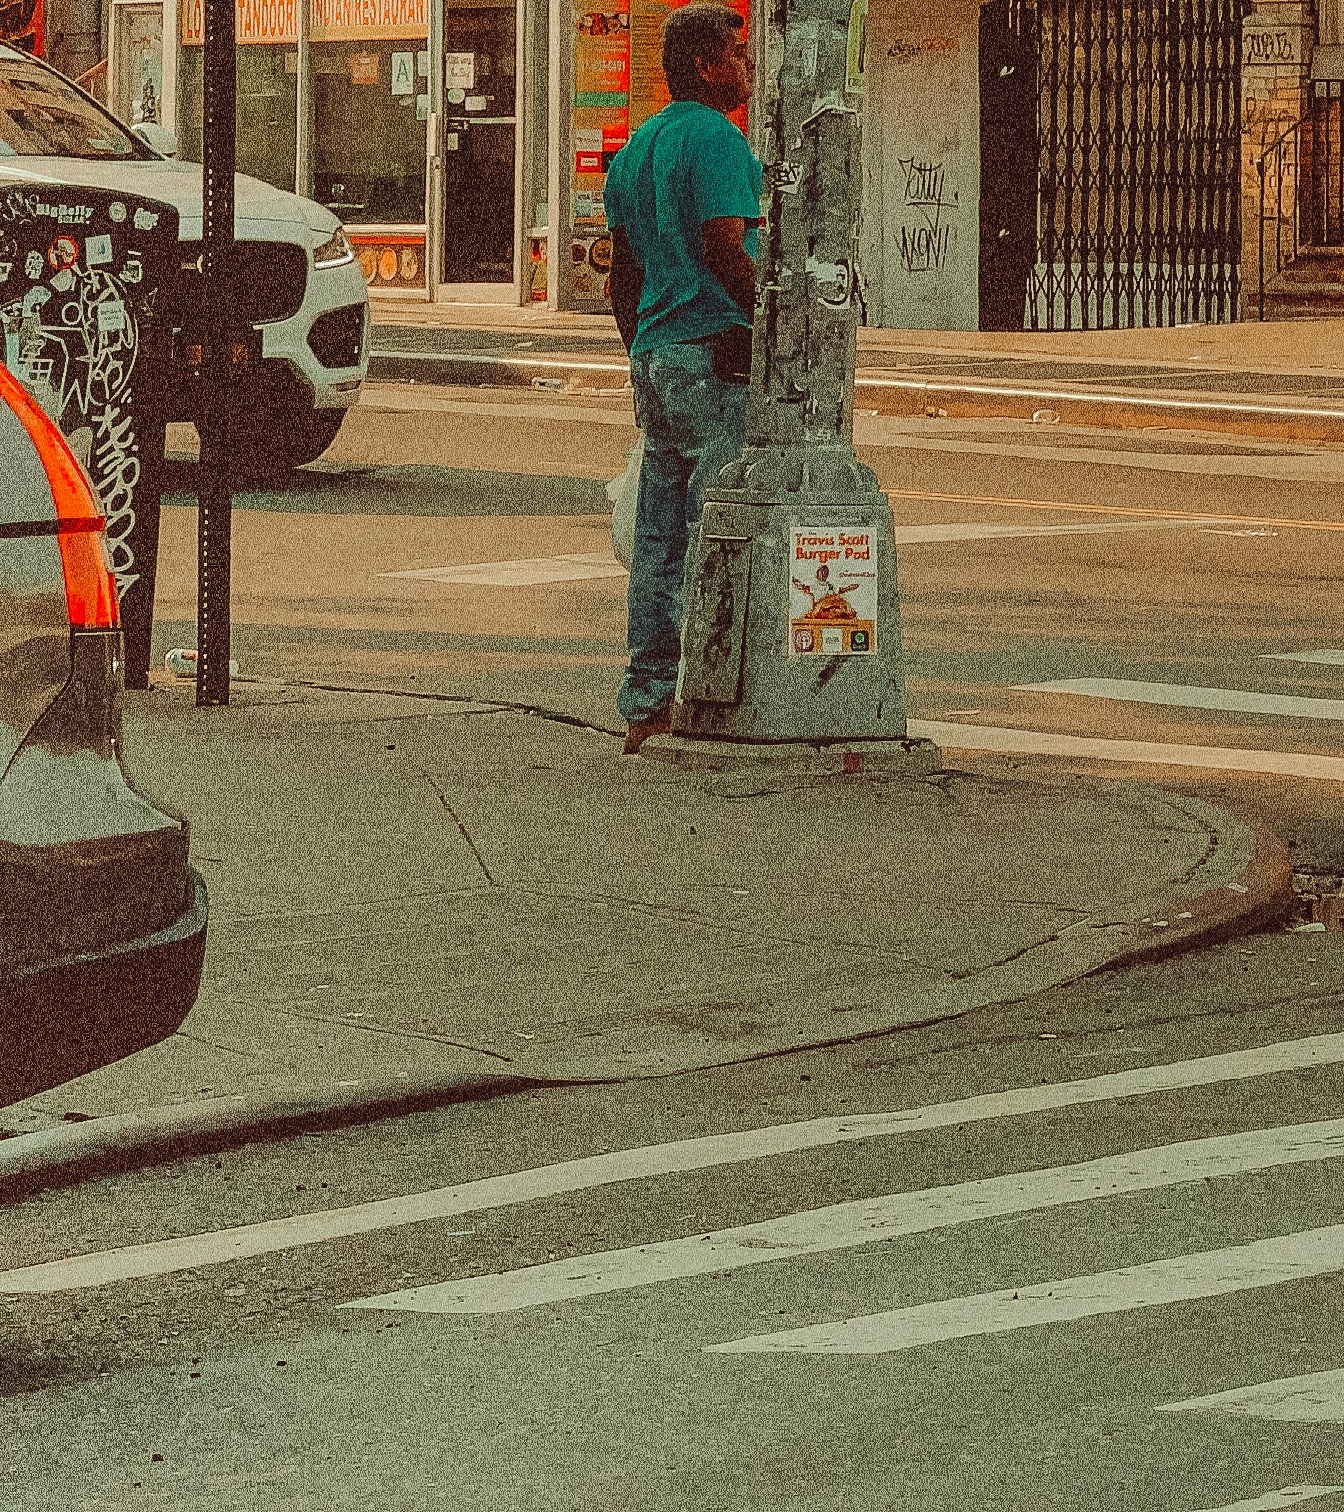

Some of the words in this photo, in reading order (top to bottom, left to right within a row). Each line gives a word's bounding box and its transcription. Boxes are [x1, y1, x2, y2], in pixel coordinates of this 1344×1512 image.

[795, 533, 834, 546] Travis
[838, 533, 869, 546] Scott
[795, 547, 840, 563] Burger
[845, 547, 870, 560] Pod
